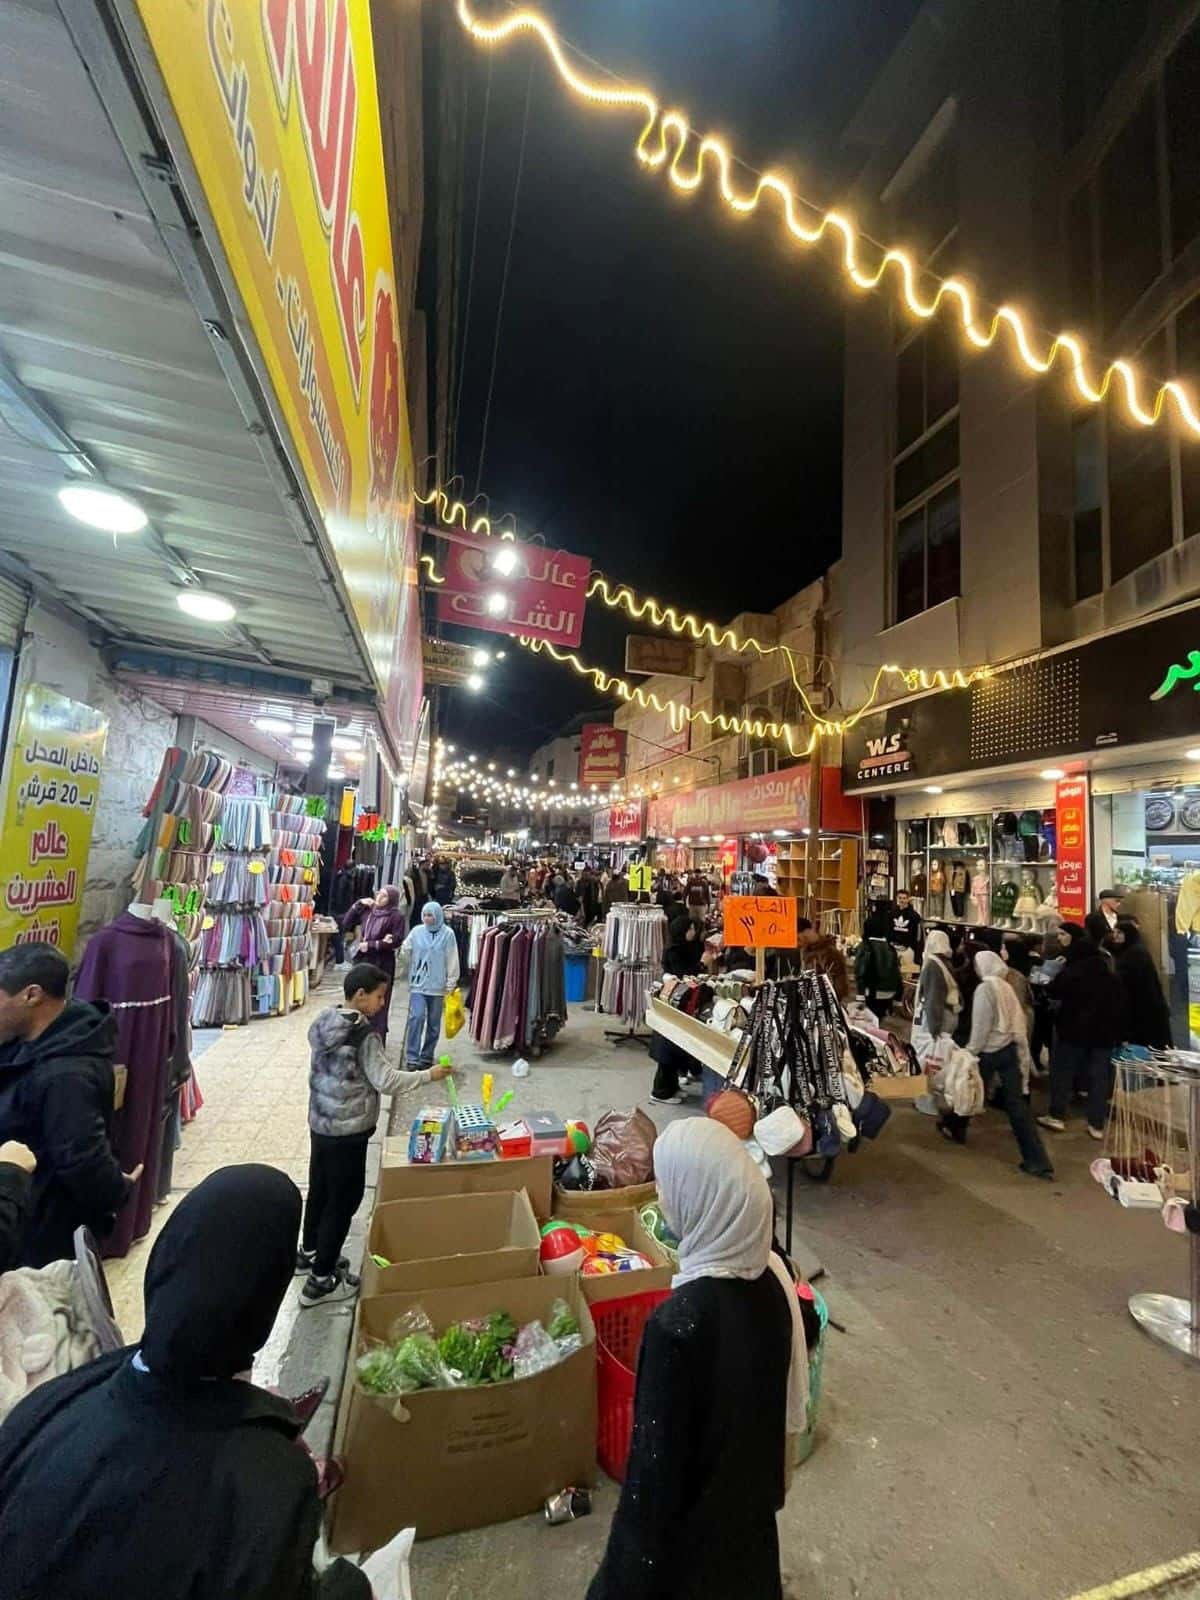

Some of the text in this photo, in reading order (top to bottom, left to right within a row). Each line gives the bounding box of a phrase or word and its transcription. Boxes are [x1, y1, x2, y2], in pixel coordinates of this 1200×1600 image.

[26, 740, 100, 775] داخل المحل
[857, 761, 911, 780] CENTERE
[20, 776, 57, 806] قرش
[61, 783, 79, 805] 20
[31, 823, 68, 864] عالم
[7, 869, 76, 915] العشرين
[636, 866, 646, 890] 1
